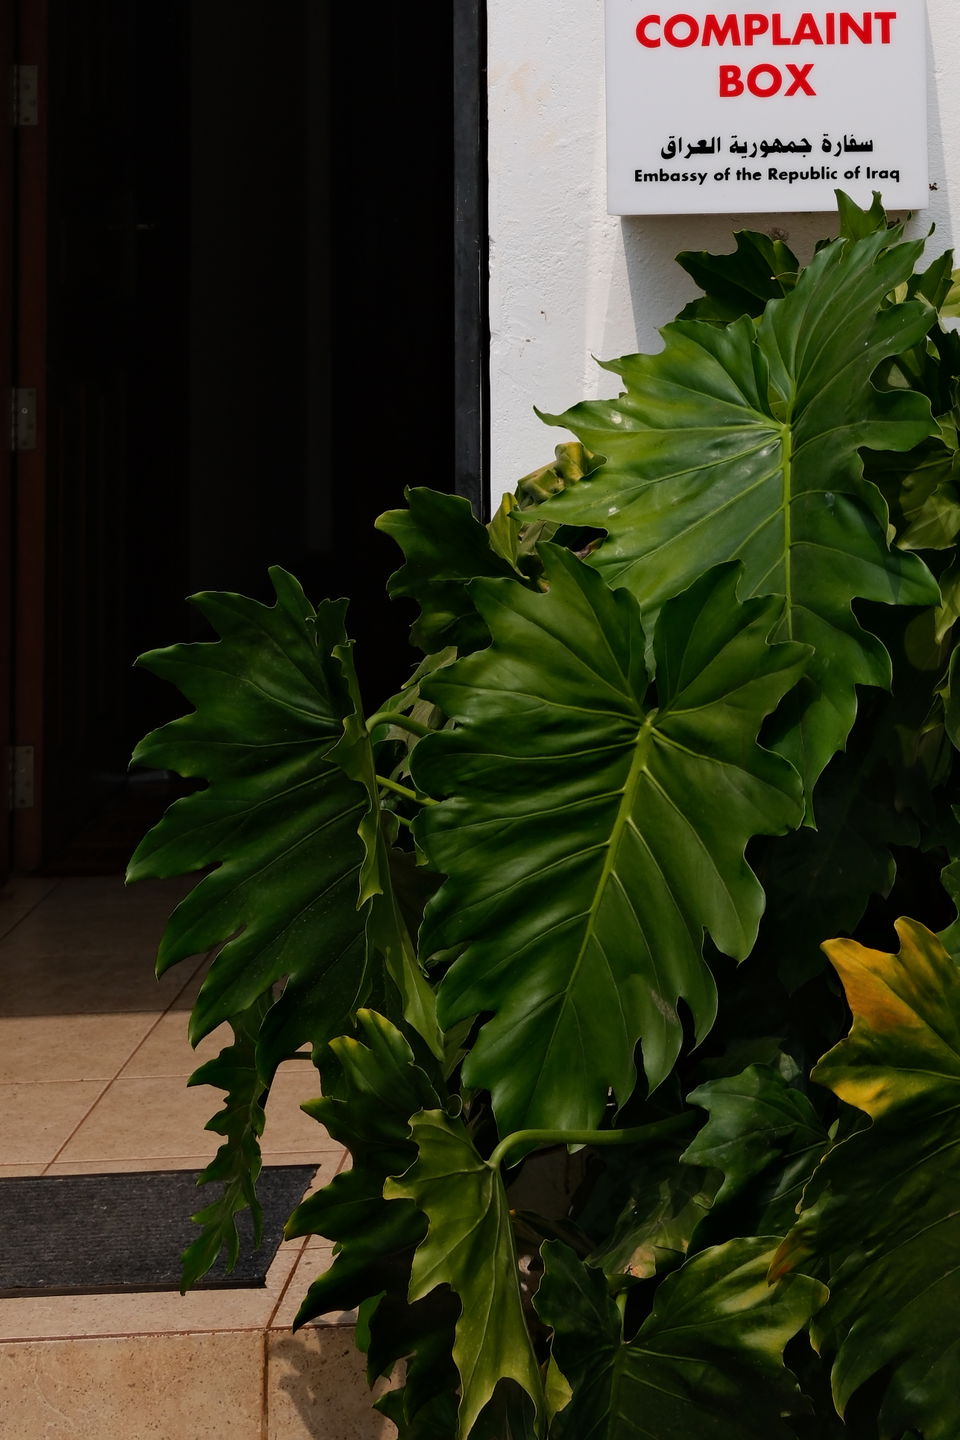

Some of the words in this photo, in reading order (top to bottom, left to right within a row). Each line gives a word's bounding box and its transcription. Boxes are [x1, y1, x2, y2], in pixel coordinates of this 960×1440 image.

[636, 11, 897, 48] COMPLAINT
[719, 63, 816, 98] BOX
[661, 136, 720, 159] العراق
[730, 135, 812, 158] جمهورية
[822, 134, 873, 157] سفارة
[635, 168, 708, 185] Embassy
[714, 167, 730, 181] of
[736, 167, 761, 180] the
[768, 166, 837, 184] Republic
[844, 166, 860, 179] of
[867, 167, 899, 182] Iraq
